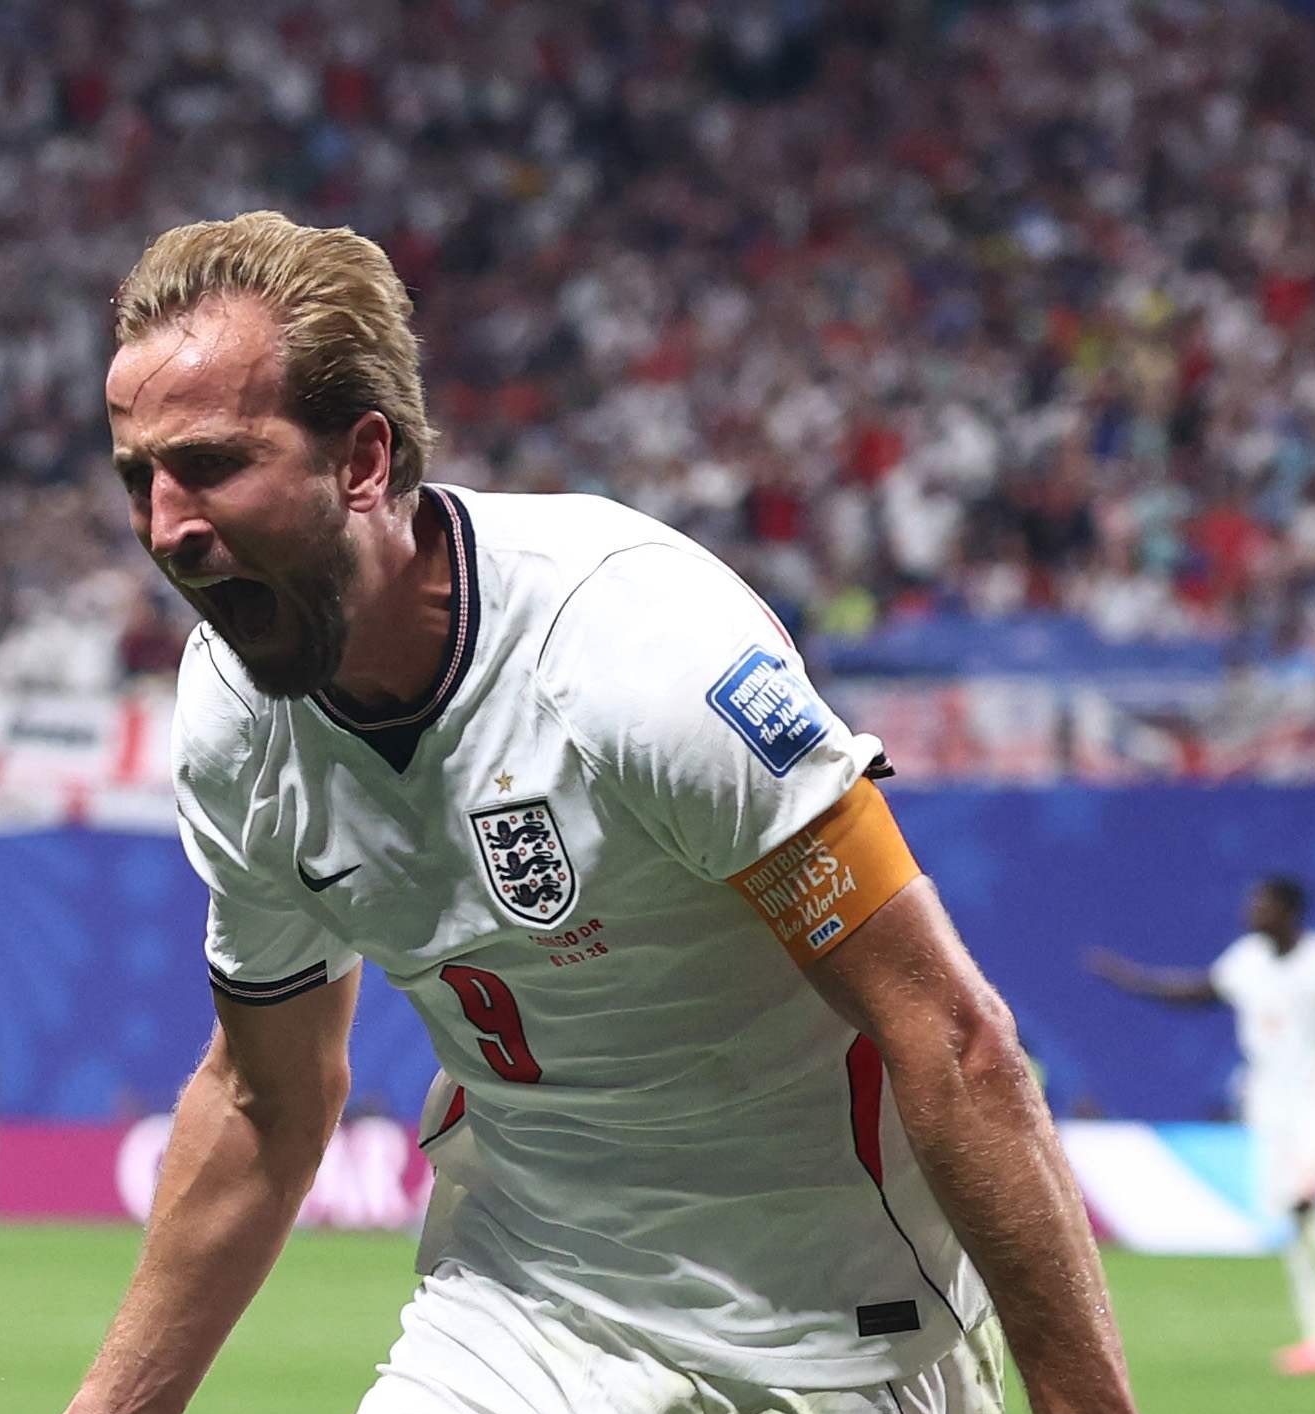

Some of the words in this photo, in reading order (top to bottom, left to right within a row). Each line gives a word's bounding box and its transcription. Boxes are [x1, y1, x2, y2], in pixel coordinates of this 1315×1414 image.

[729, 660, 776, 710] FOOTBALL
[742, 677, 793, 727] UNITE
[759, 723, 784, 745] the
[787, 717, 811, 741] FIFA
[743, 831, 823, 896] FOOTBALL
[757, 846, 839, 918] UNITES
[797, 865, 857, 926] World
[809, 920, 842, 947] FIFA
[439, 964, 543, 1084] 9
